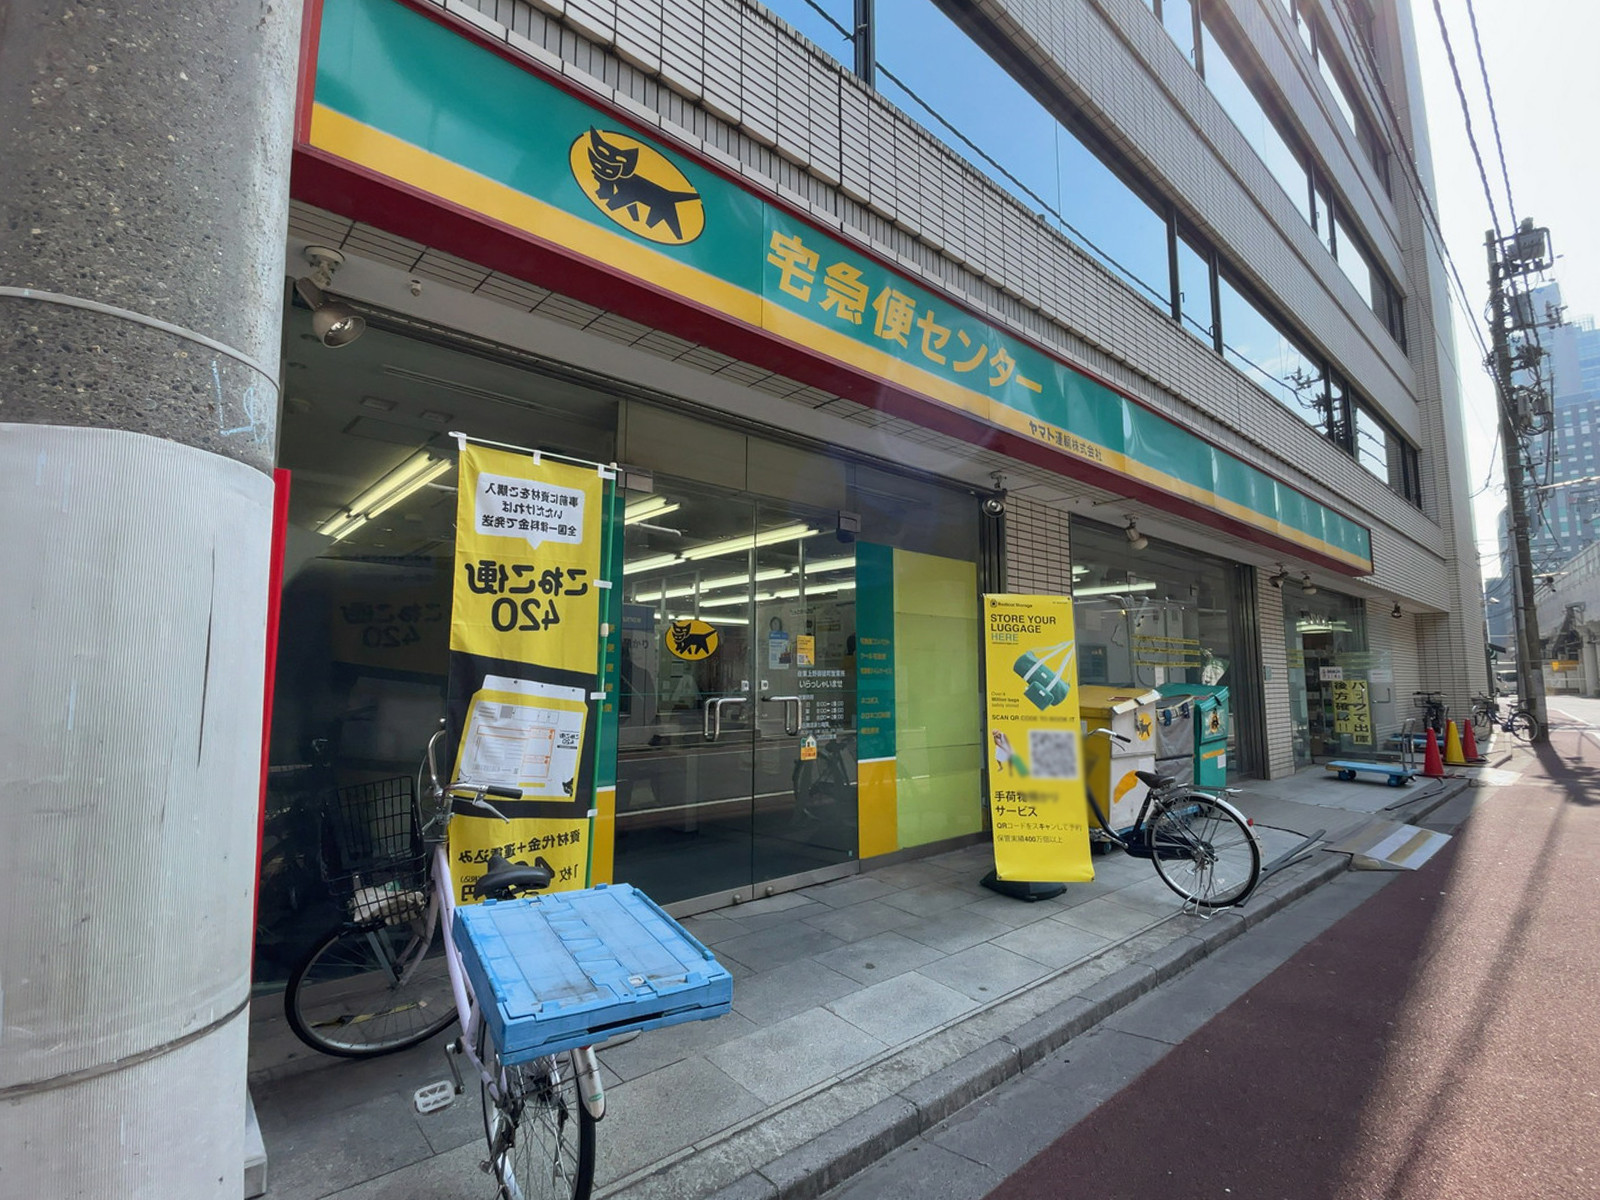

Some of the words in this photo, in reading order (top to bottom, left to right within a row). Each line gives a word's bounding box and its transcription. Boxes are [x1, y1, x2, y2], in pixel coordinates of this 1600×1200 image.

[766, 229, 1043, 395] 宅急便センター
[1028, 419, 1103, 462] ヤマト運輸株式会社
[990, 613, 1025, 624] STORE
[1027, 615, 1056, 625] YOUR
[990, 623, 1042, 634] LUGGAGE
[991, 632, 1019, 642] HERE
[799, 679, 843, 689] いらっしゃいませ
[995, 806, 1038, 817] サービス
